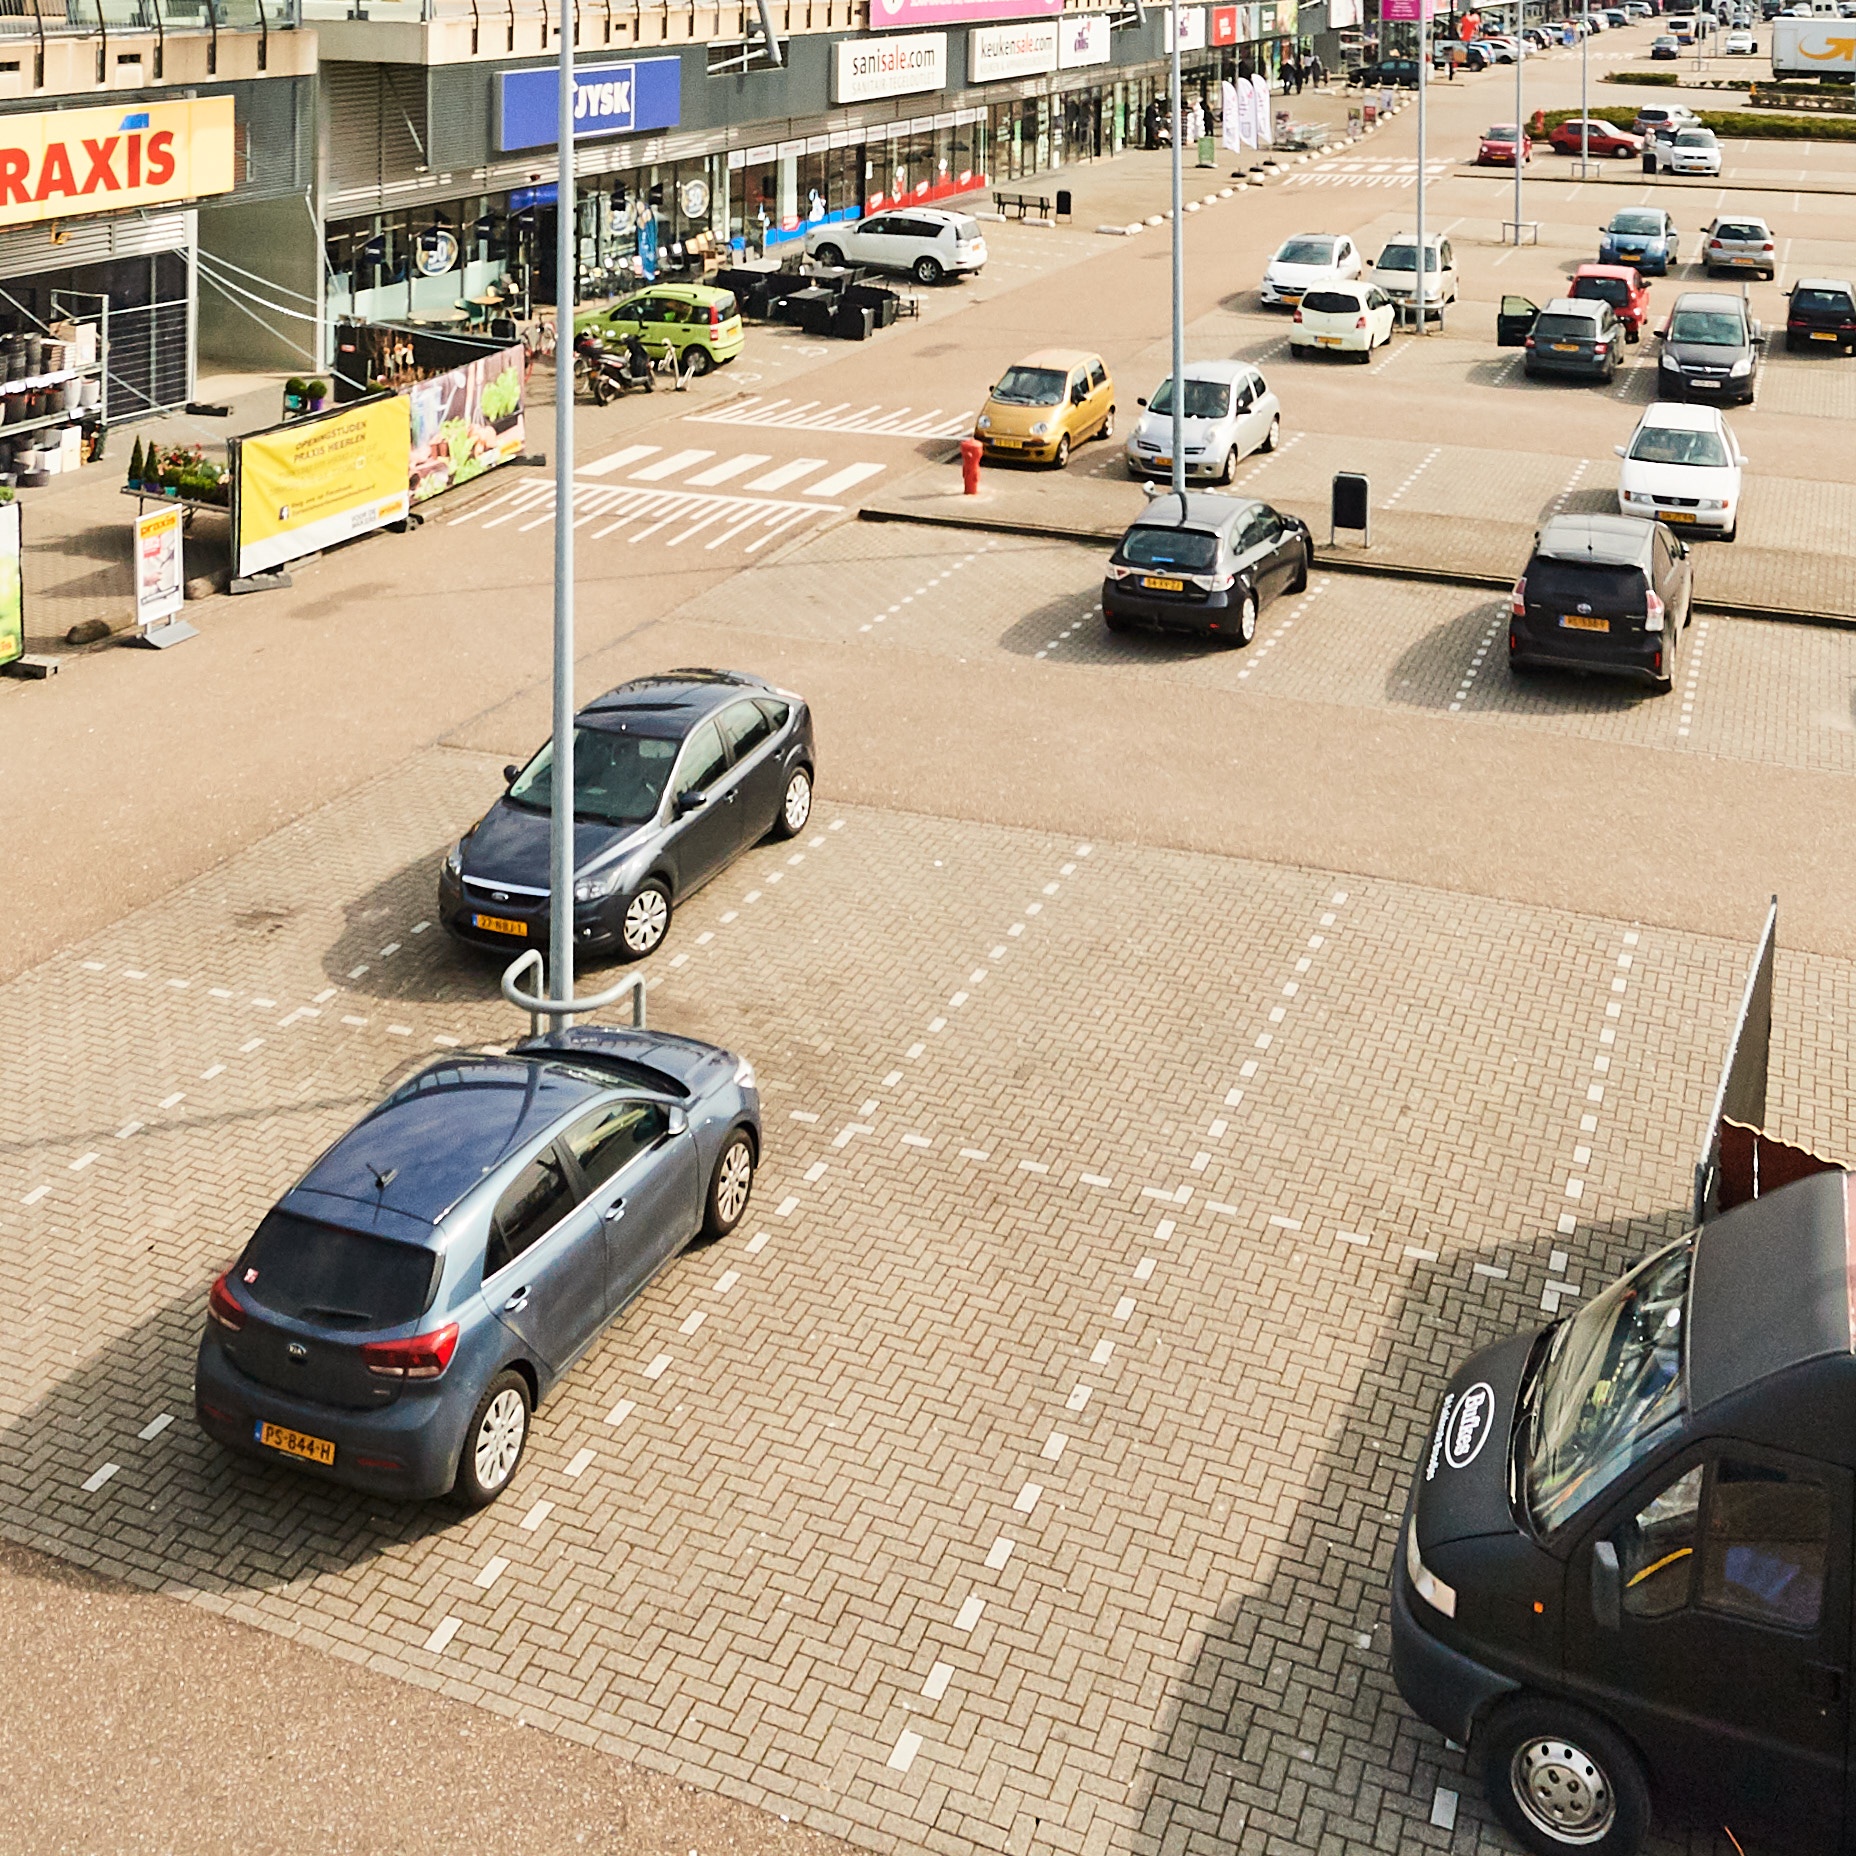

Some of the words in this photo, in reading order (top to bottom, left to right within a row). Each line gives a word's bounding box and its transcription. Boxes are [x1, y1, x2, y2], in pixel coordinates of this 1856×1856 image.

[853, 43, 935, 76] sanisale.com
[981, 31, 1053, 59] keukensale.com
[574, 80, 631, 119] JYSK
[140, 515, 176, 537] praxis
[1453, 1390, 1487, 1457] Bufkes
[266, 1426, 331, 1461] PS-844-H
